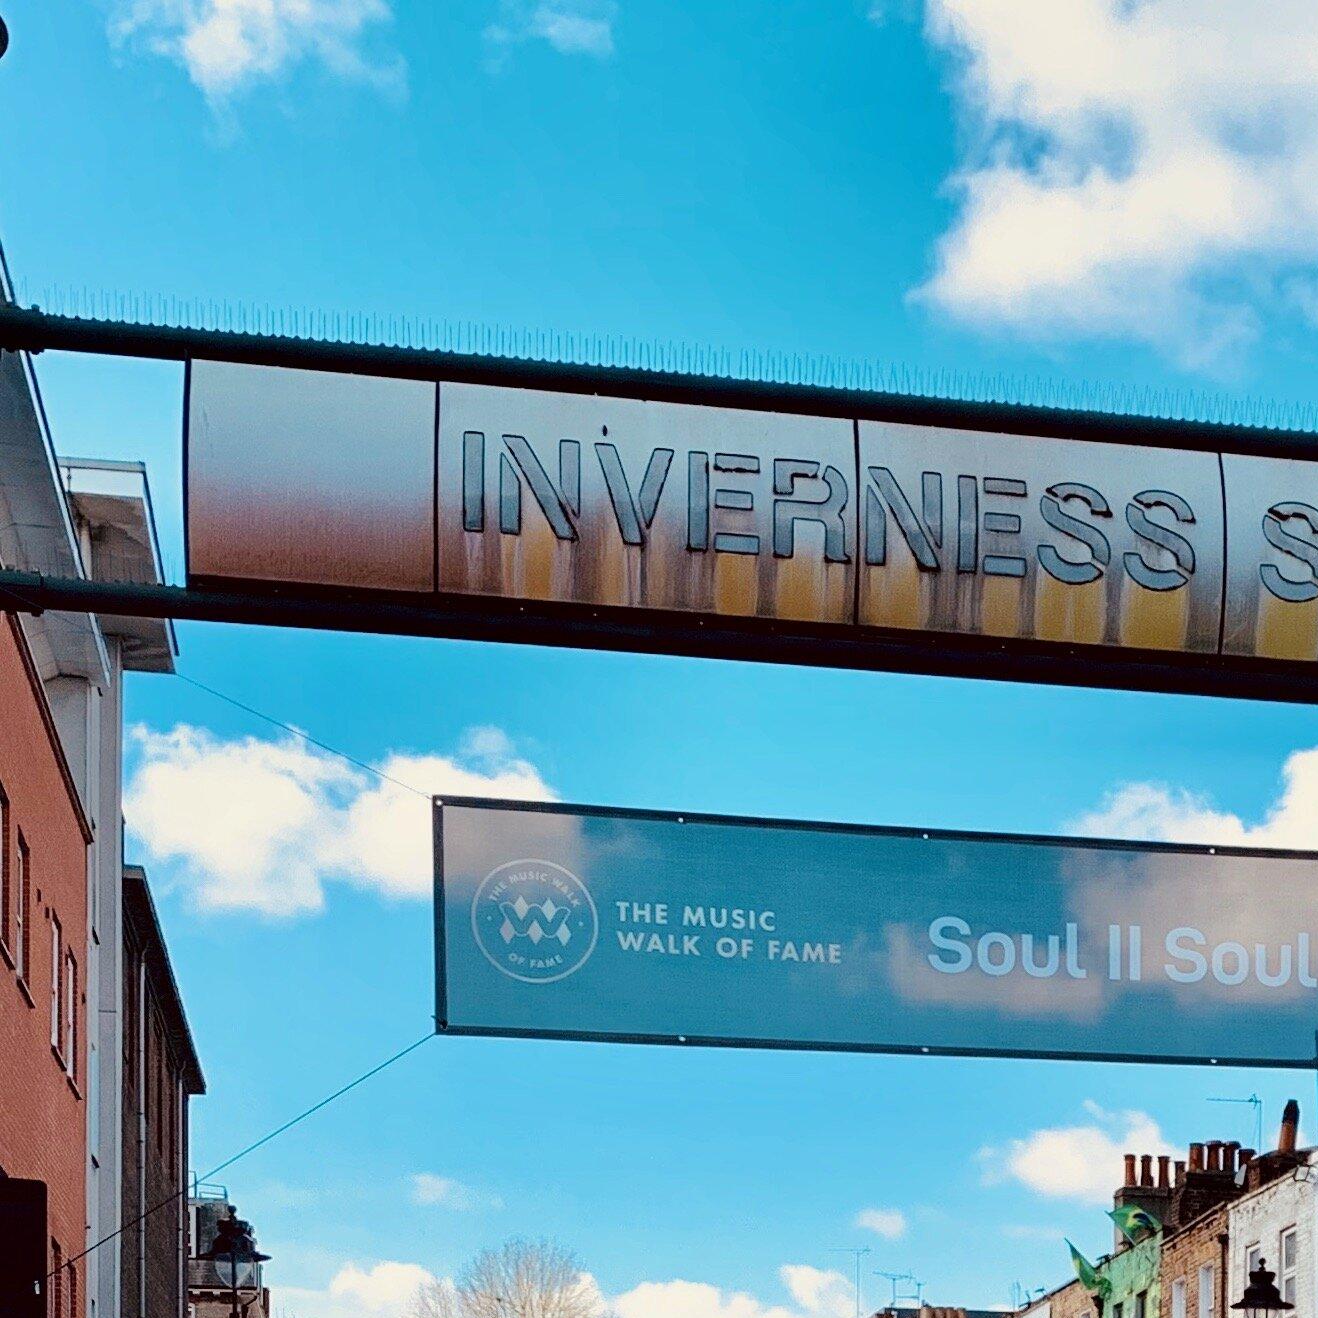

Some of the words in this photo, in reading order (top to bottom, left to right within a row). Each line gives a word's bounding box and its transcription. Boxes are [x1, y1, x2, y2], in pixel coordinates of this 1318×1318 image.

[462, 430, 1197, 591] INVERNESS
[488, 880, 508, 901] THE
[508, 870, 549, 883] MUSIC
[551, 878, 580, 908] WALK
[616, 900, 668, 926] THE
[682, 904, 776, 932] MUSIC
[508, 952, 526, 965] OF
[529, 954, 564, 969] FAME
[616, 929, 701, 957] WALK
[715, 933, 757, 960] OF
[767, 937, 843, 965] FAME
[927, 914, 1087, 980] Soul
[1164, 926, 1318, 989] Soul
